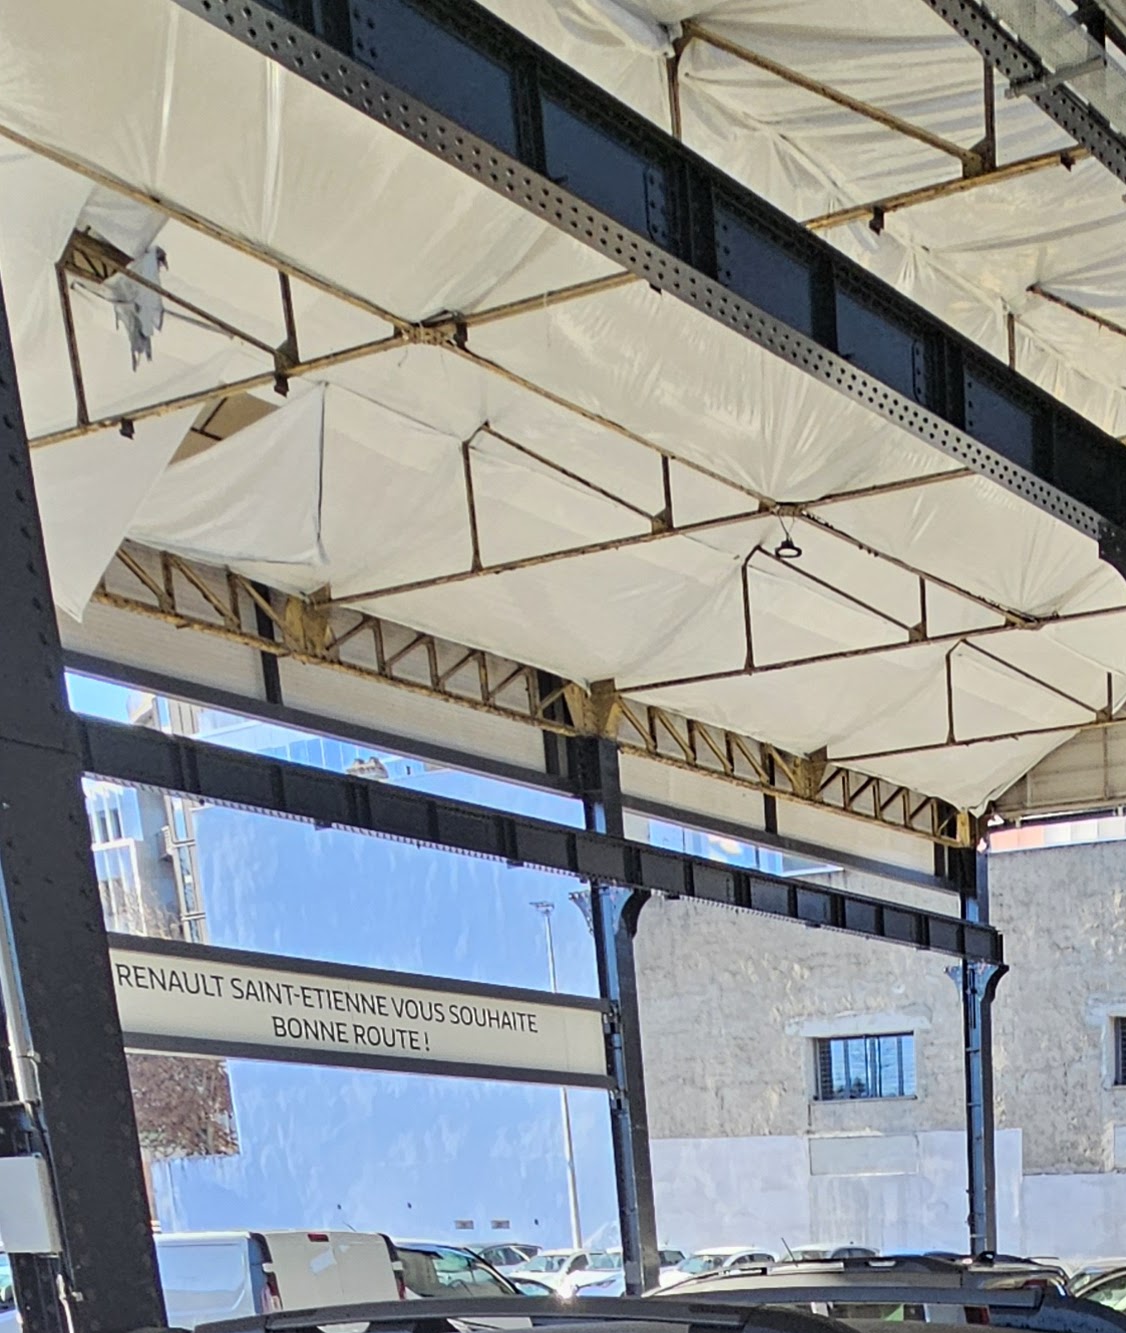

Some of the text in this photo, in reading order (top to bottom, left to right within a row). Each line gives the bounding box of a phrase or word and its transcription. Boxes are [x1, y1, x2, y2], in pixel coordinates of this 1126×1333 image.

[115, 962, 538, 1034] RENAULT SAINT-ETIENNE VOUS SOUHAITE
[272, 1015, 349, 1043] BONNE
